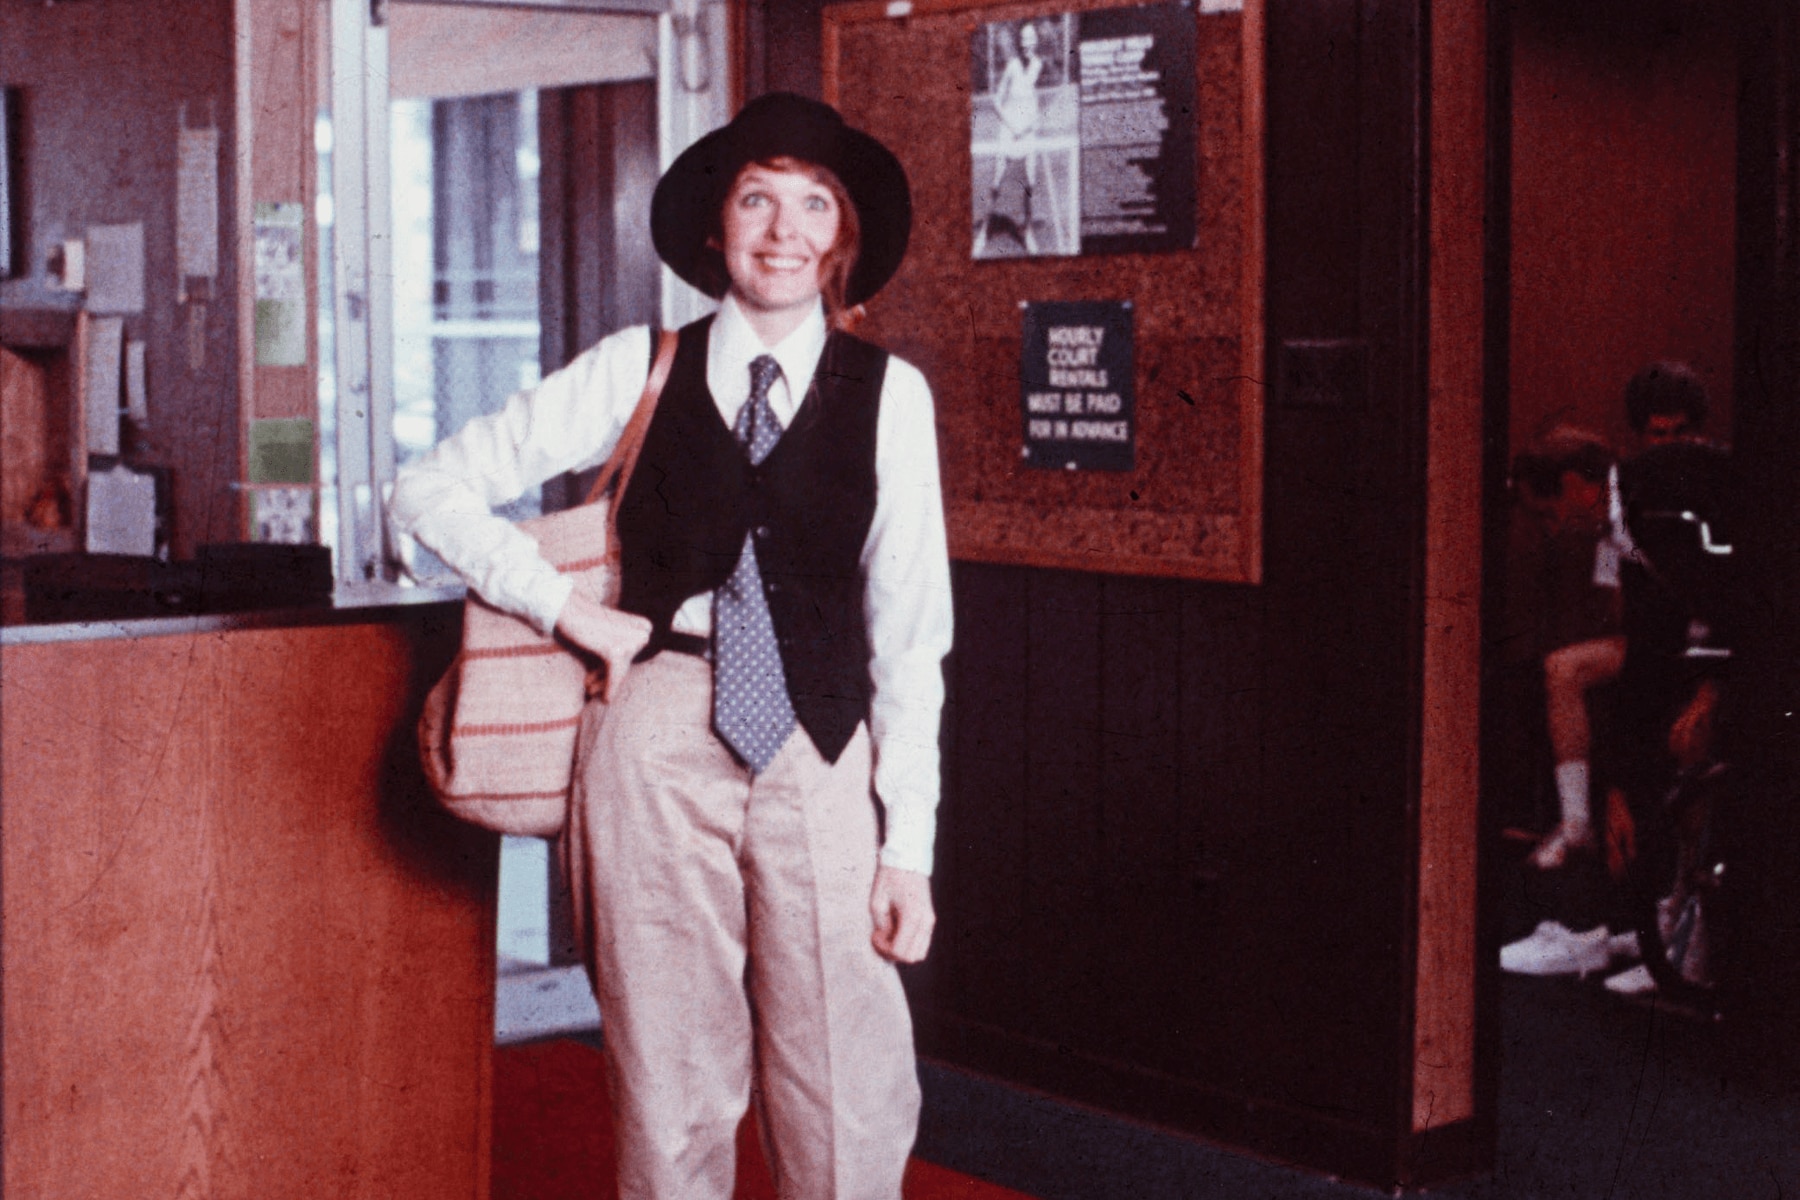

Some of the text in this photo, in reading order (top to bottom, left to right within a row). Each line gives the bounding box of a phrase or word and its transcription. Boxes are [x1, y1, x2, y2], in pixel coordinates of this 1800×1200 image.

[1048, 326, 1104, 345] HOURLY
[1047, 348, 1098, 366] COURT
[1087, 393, 1121, 413] PAID
